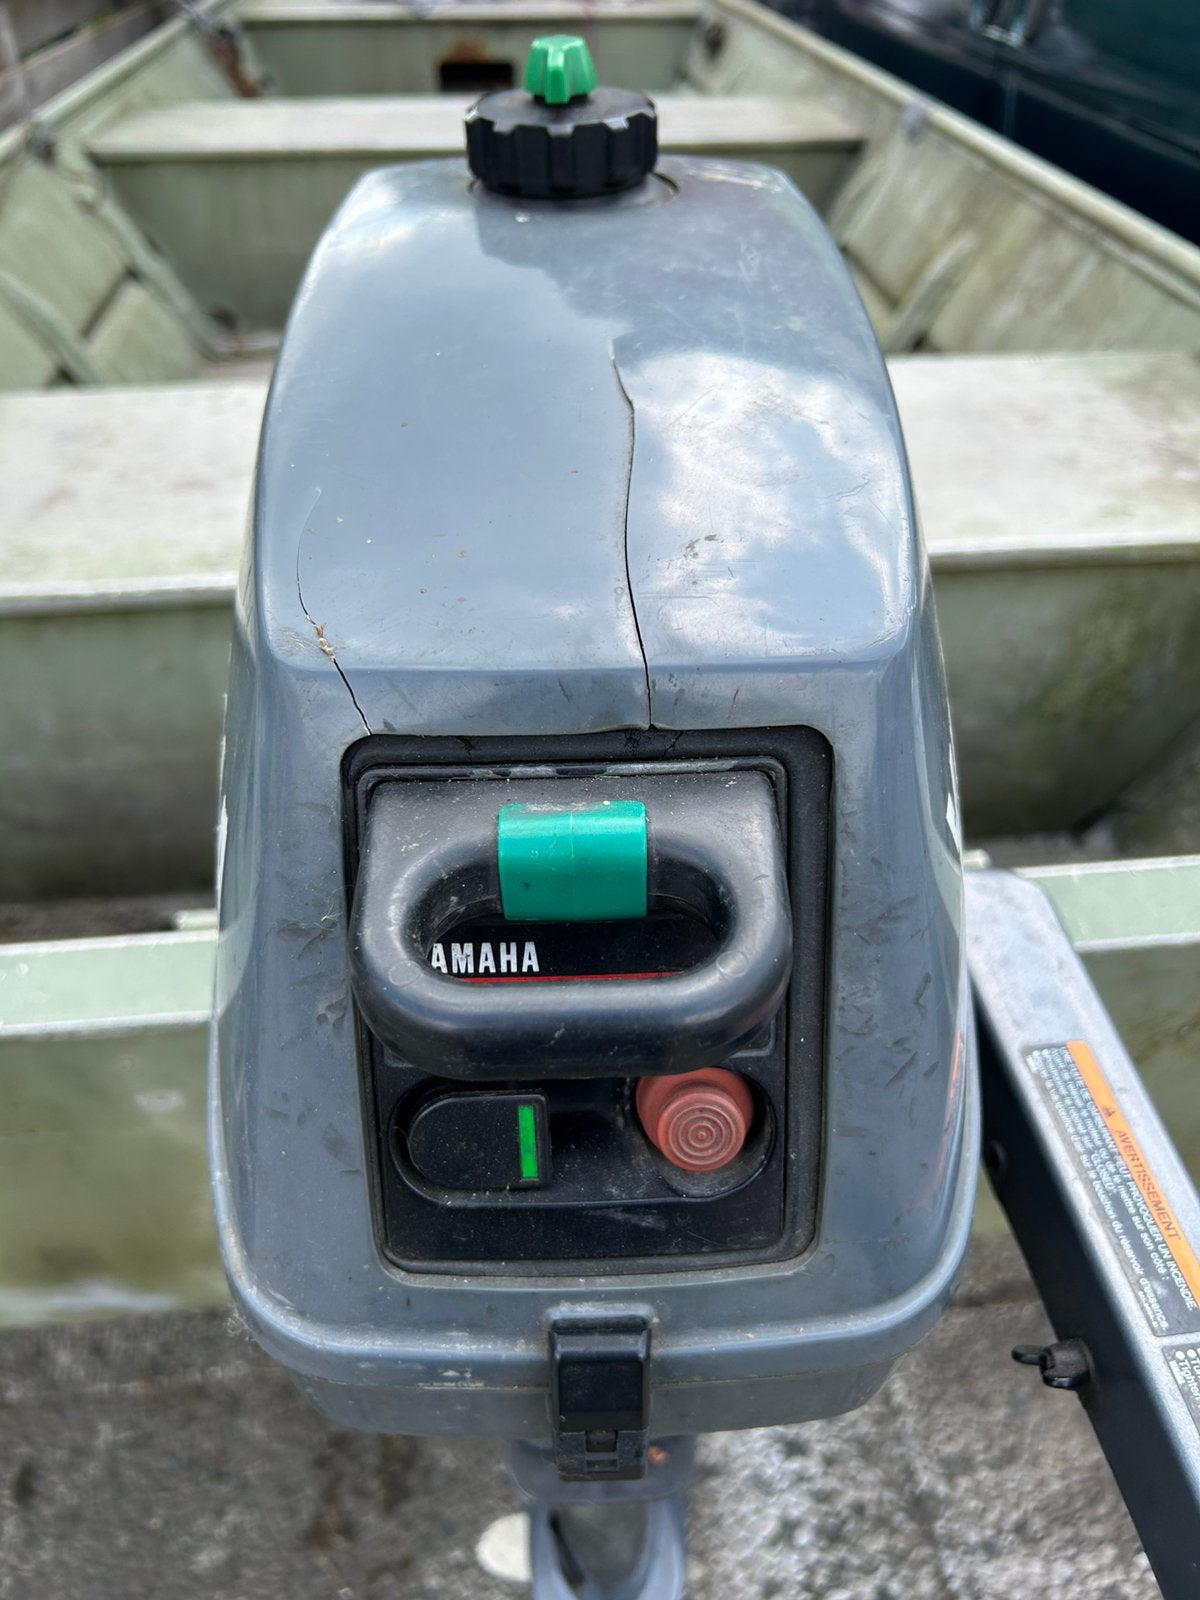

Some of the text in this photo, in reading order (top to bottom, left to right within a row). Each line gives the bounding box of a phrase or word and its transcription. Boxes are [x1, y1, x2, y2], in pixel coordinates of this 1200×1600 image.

[431, 941, 540, 974] AMAHA
[1116, 1129, 1180, 1241] AVERTISSEMENT
[1117, 1186, 1137, 1213] mettre
[1132, 1216, 1145, 1231] sur
[1140, 1233, 1153, 1249] son
[1092, 1181, 1118, 1218] bouchon
[1112, 1221, 1125, 1233] du
[1139, 1279, 1171, 1330] d'essence.
[1127, 1182, 1162, 1241] PROVOQUER
[1158, 1244, 1171, 1259] UN
[1166, 1261, 1197, 1311] INCENDIE.
